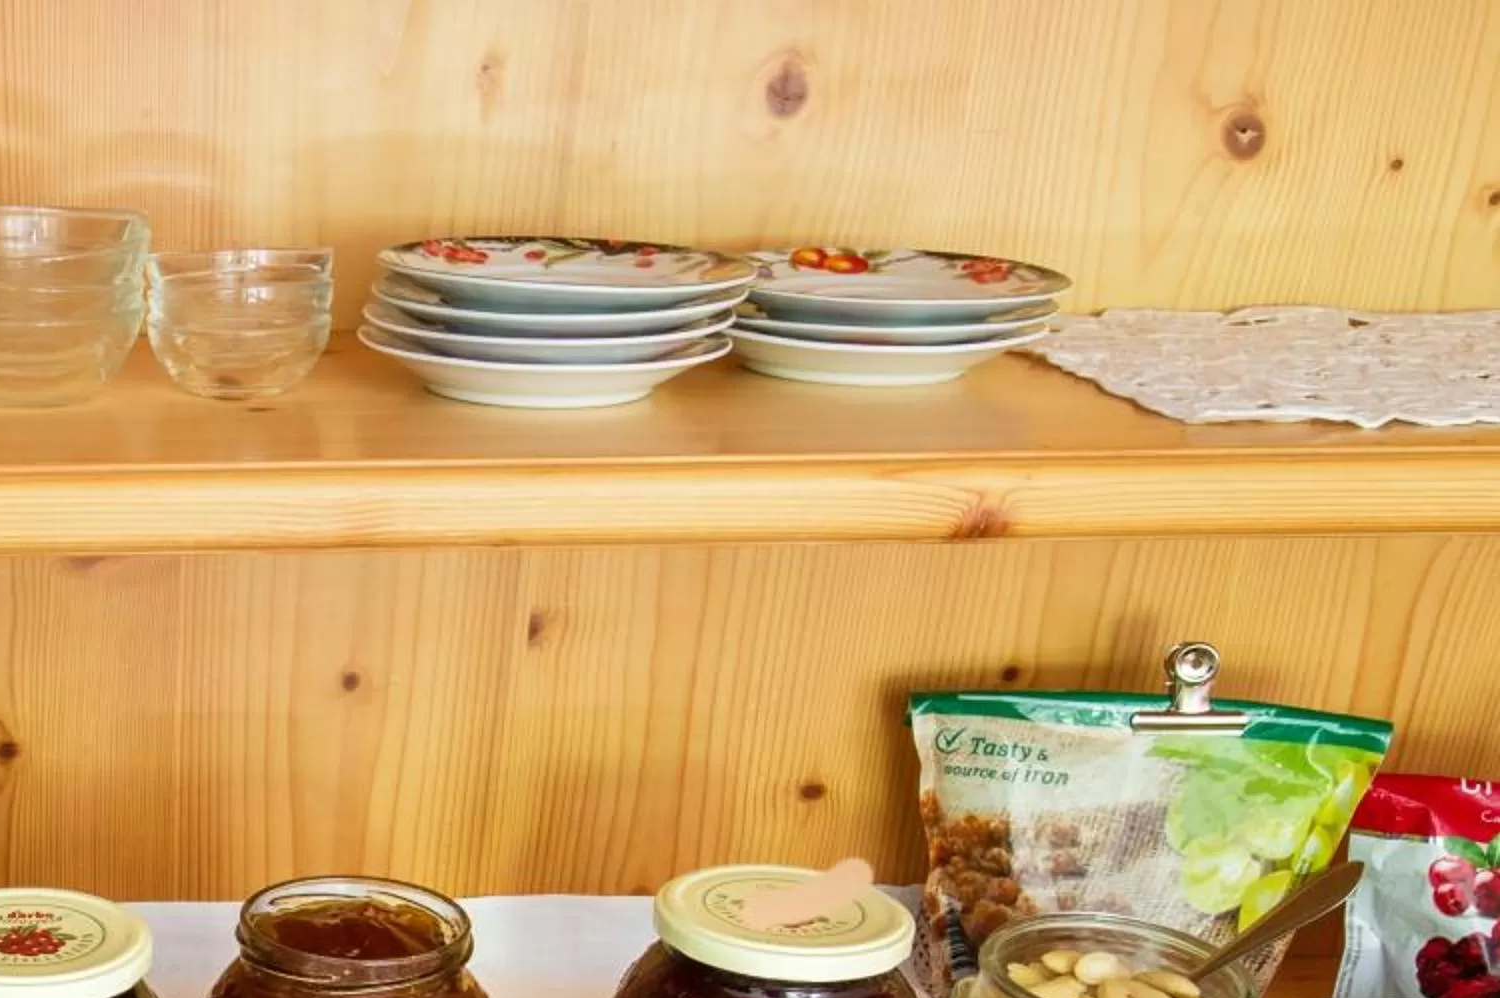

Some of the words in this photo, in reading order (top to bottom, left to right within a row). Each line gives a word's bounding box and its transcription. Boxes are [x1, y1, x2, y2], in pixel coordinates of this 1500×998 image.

[970, 736, 1033, 763] Tasty
[1036, 748, 1049, 761] &
[944, 764, 997, 779] source
[1024, 764, 1069, 785] iron
